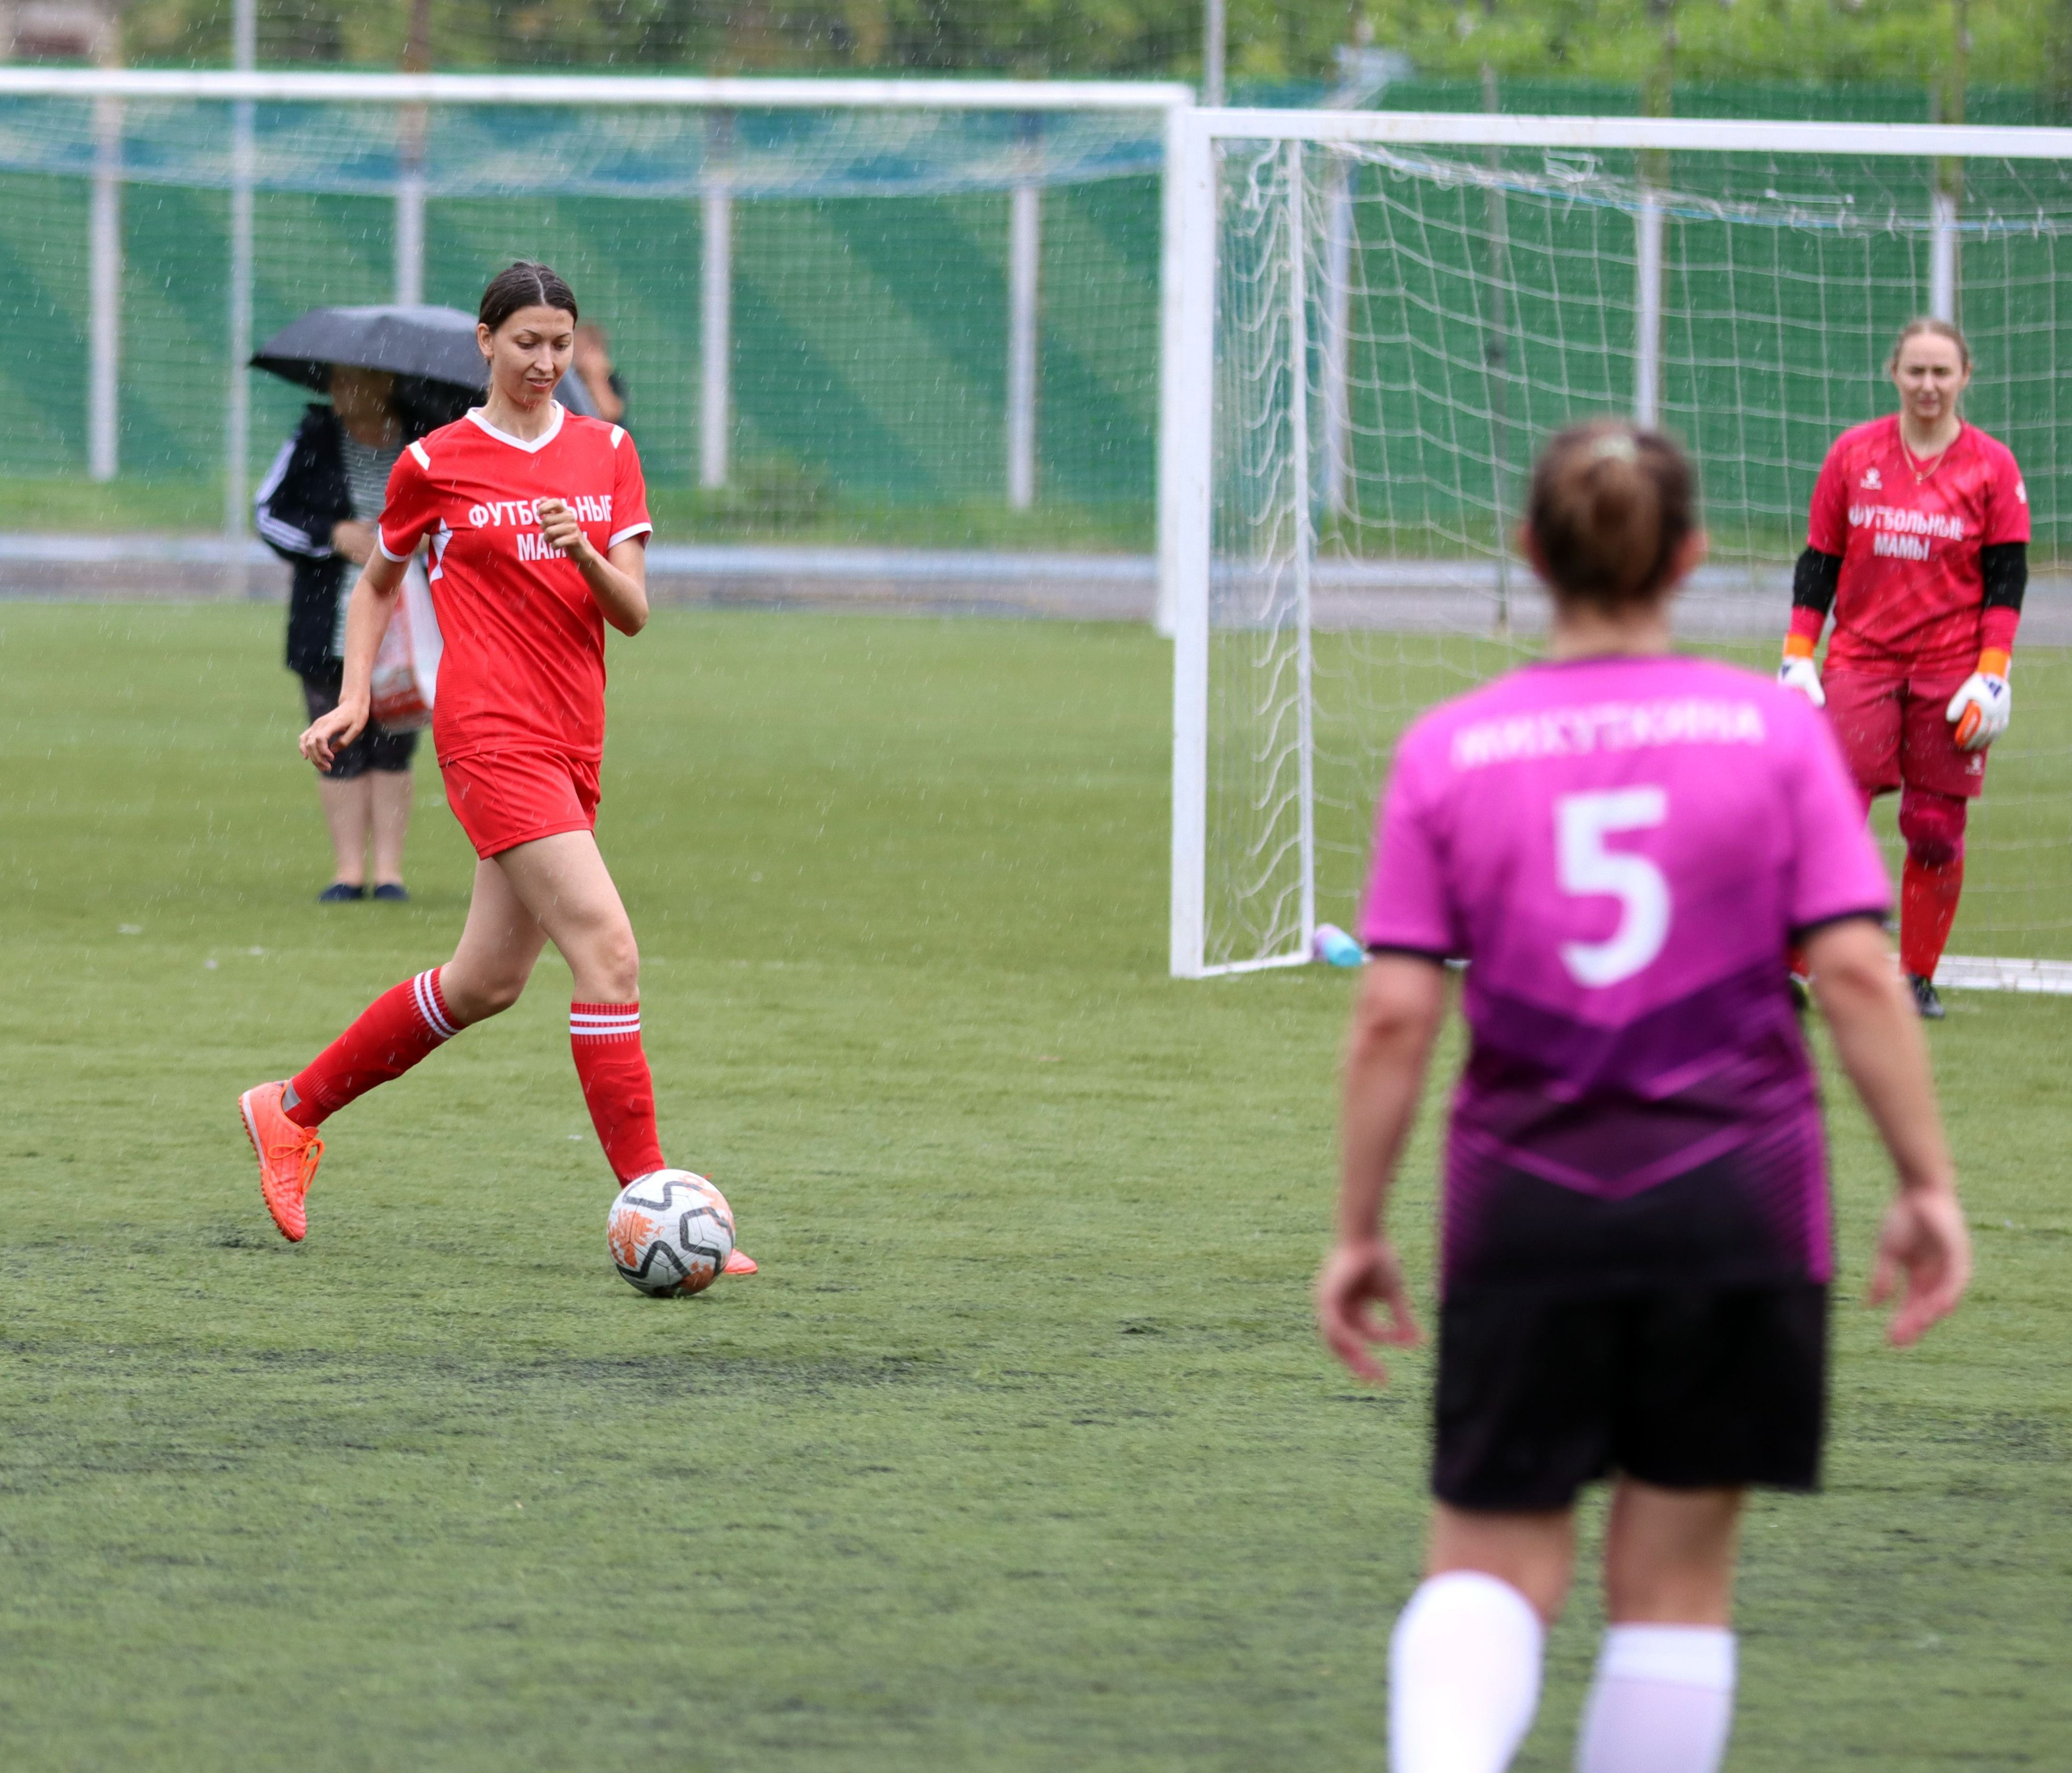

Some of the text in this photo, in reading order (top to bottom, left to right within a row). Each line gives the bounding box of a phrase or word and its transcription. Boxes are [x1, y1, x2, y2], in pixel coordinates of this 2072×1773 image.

[469, 495, 611, 528] ФУТБЬНЫЕ
[1874, 532, 1931, 562] МАМЫ
[1560, 787, 1670, 986] 5
